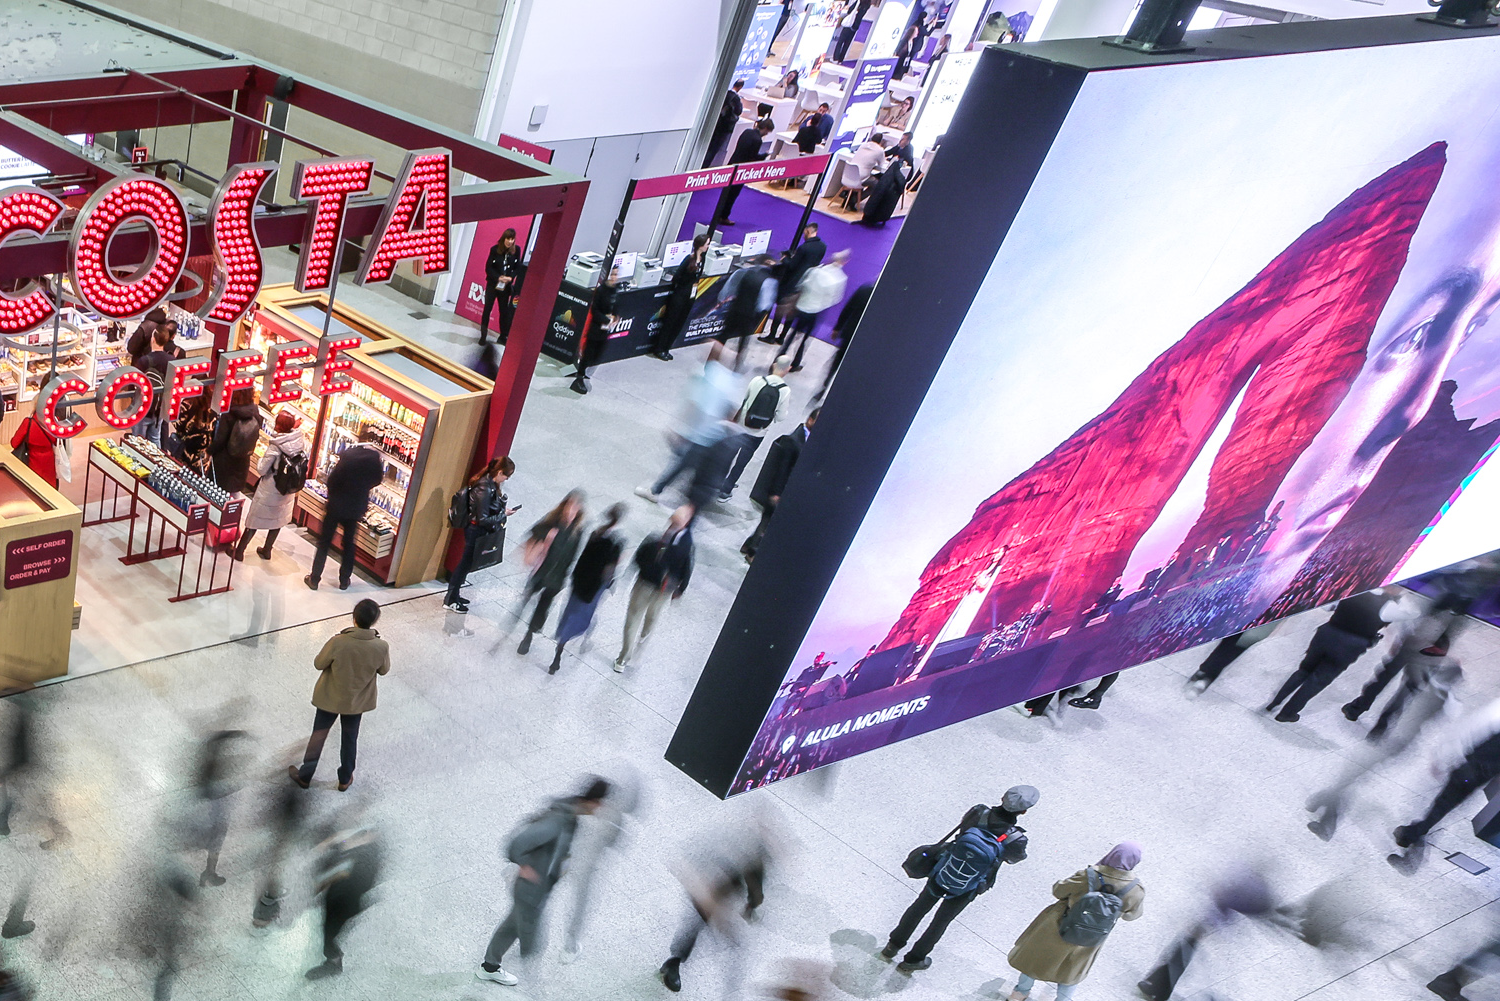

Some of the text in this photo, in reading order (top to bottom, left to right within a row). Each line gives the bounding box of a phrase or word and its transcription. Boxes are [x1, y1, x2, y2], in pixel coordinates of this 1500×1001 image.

[685, 166, 786, 188] Print Your Ticket Here
[36, 333, 362, 438] COFFEE
[25, 538, 66, 552] SELF ORDER
[9, 570, 33, 581] ORDER
[38, 566, 52, 576] PAY
[23, 559, 52, 570] BROWSE
[800, 695, 932, 747] ALULA MOMENTS
